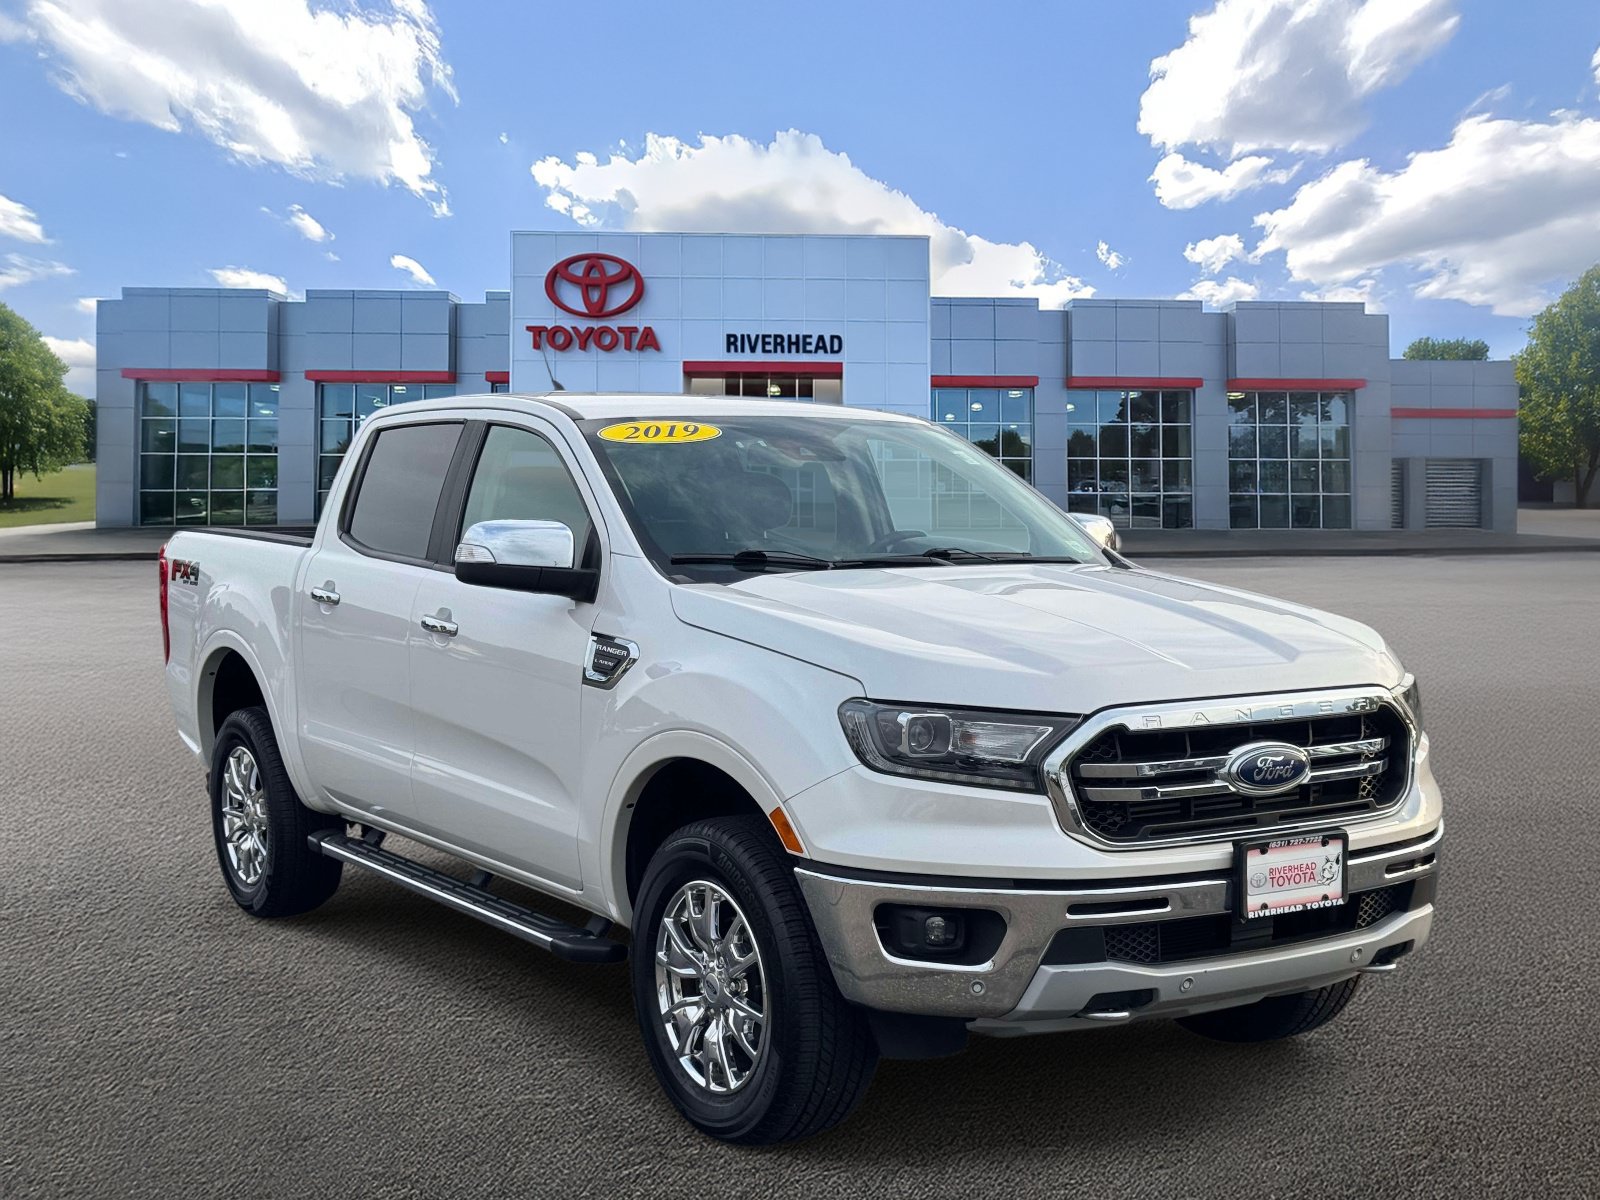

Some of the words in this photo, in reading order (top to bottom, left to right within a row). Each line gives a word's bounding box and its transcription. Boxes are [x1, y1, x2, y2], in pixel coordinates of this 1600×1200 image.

[526, 325, 661, 352] TOYOTA
[725, 333, 844, 354] RIVERHEAD
[623, 424, 700, 440] 2019
[171, 558, 201, 582] FX4
[596, 644, 628, 657] RANGER
[1141, 696, 1373, 728] RANGER
[1253, 754, 1296, 782] Ford
[1268, 840, 1288, 849] (631)
[1268, 861, 1317, 877] RIVERHEAD
[1269, 871, 1316, 889] TOYOTA
[1248, 904, 1303, 919] RIVERHEAD
[1305, 898, 1345, 910] TOYOTA
